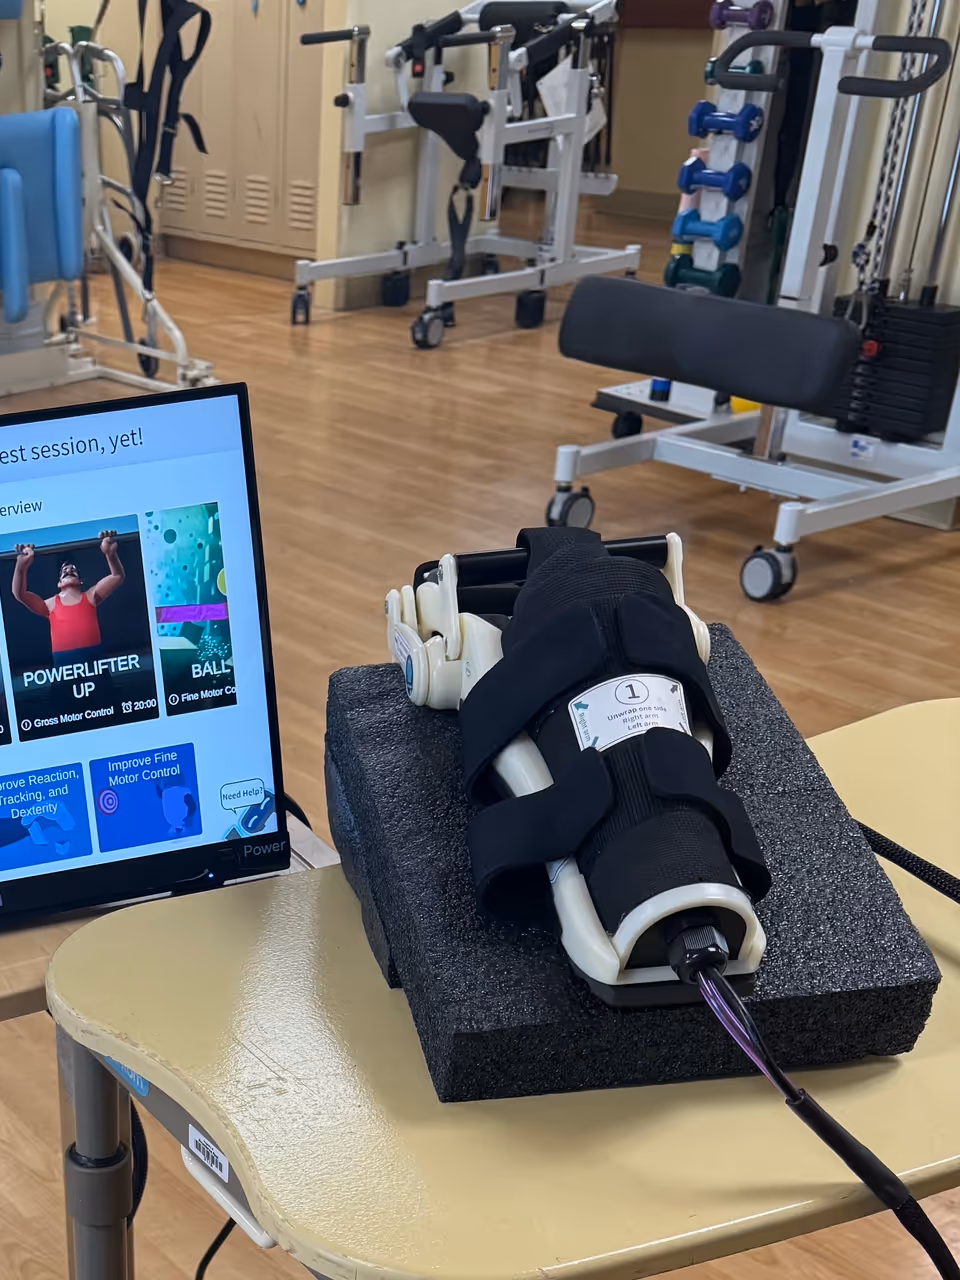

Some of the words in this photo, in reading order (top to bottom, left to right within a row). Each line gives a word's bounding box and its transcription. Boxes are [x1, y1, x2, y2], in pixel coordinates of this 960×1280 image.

[31, 435, 105, 459] session,
[108, 427, 144, 454] yet!
[22, 654, 140, 688] POWERLIFTER
[191, 659, 231, 679] BALL
[72, 682, 96, 700] UP
[181, 692, 199, 703] Fine
[200, 687, 224, 700] Motor
[625, 683, 640, 699] 1
[134, 698, 158, 712] 20:00
[607, 707, 637, 721] Unwrap
[34, 715, 59, 729] Gross
[60, 710, 84, 725] Motor
[84, 706, 115, 720] Control
[579, 712, 589, 729] Right
[622, 713, 643, 724] Right
[627, 722, 644, 731] Left
[107, 754, 152, 773] Improve
[154, 751, 178, 765] Fine
[28, 767, 80, 788] Reaction,
[108, 772, 141, 788] Motor
[142, 764, 181, 782] Control
[48, 783, 69, 798] and
[222, 790, 241, 800] Need
[242, 786, 263, 797] Help?
[10, 801, 59, 820] Dexterity
[243, 840, 286, 858] Power
